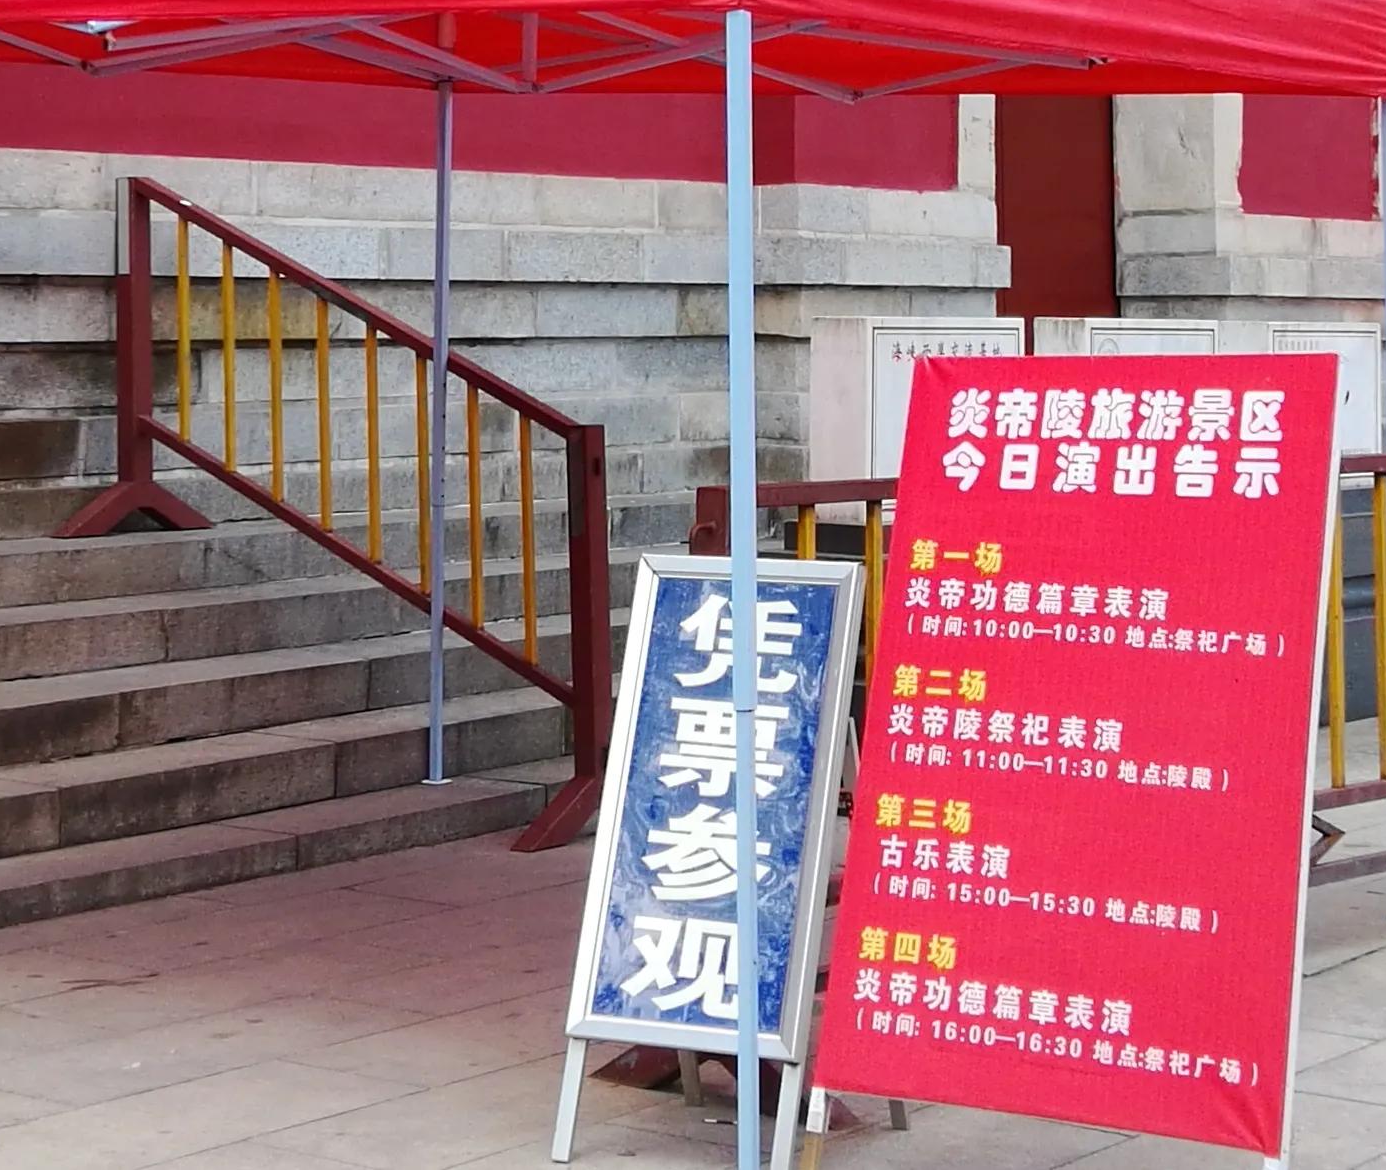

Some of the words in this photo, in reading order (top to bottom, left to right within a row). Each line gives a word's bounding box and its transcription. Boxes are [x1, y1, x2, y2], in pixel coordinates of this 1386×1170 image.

[948, 388, 1285, 443] 炎帝陵旅游景区
[942, 442, 1283, 499] 今日演出告示
[911, 539, 1003, 573] 第一场
[904, 576, 1171, 621] 炎帝功德篇章表演
[892, 664, 987, 702] 第二场
[887, 703, 1124, 753] 炎帝陵祭祀表演
[619, 592, 803, 1020] 凭票参观
[875, 793, 972, 834] 第三场
[880, 834, 1011, 879] 古乐表演
[858, 926, 958, 970] 第四场
[853, 968, 1133, 1037] 炎帝功德篇章表演
